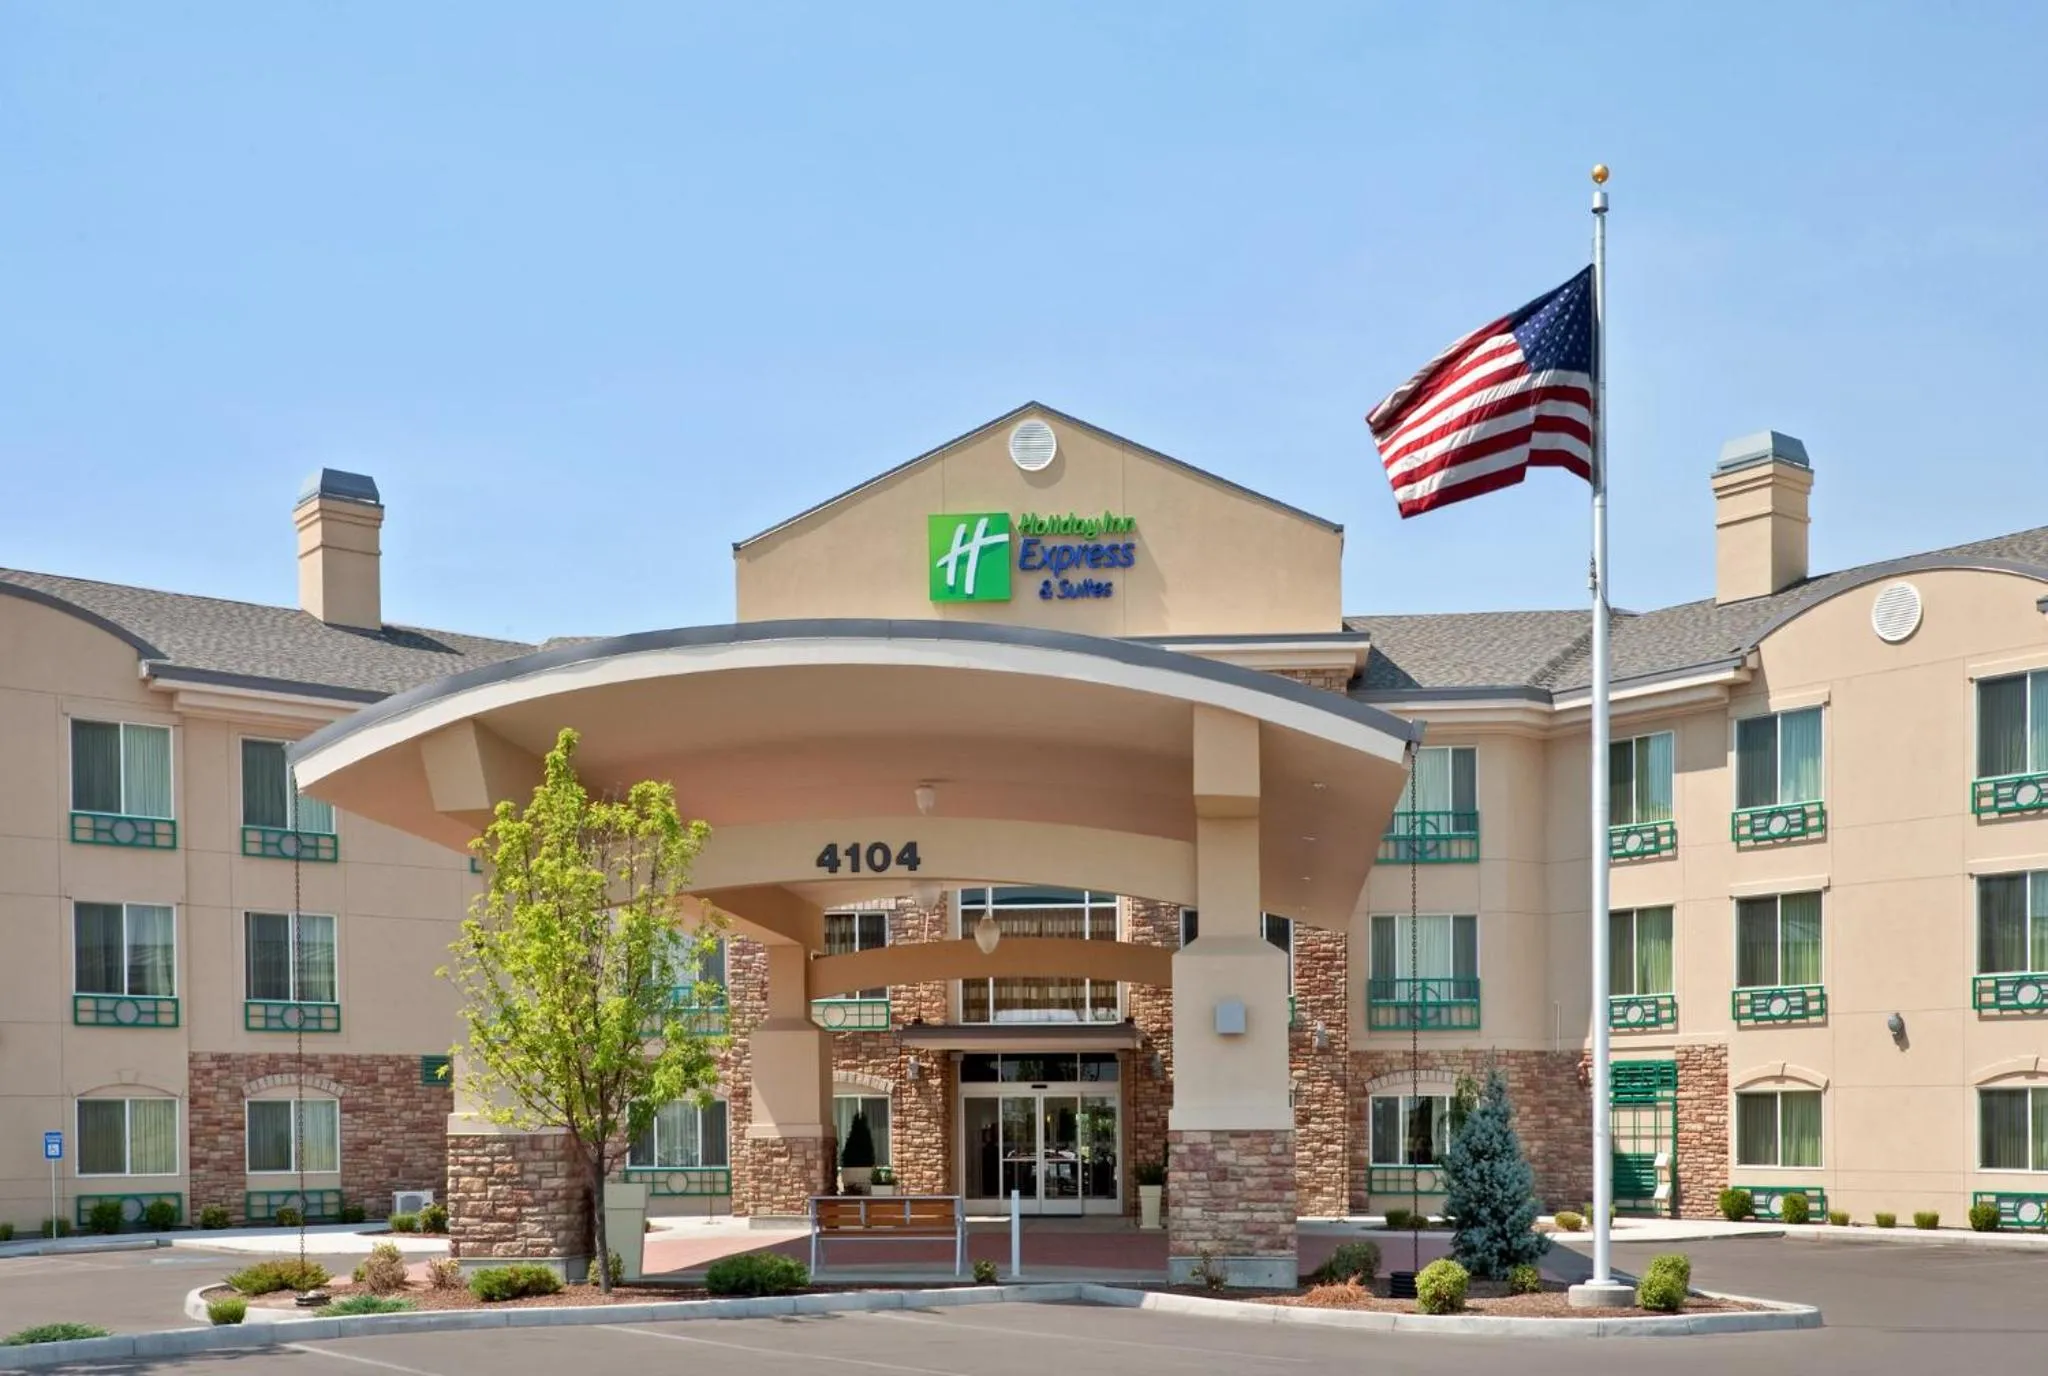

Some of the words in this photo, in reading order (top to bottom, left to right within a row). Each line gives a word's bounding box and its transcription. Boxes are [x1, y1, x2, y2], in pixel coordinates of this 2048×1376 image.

[1018, 512, 1099, 540] Holiday
[1103, 510, 1136, 533] Inn
[1018, 538, 1136, 577] Express
[1039, 579, 1053, 600] &
[1057, 578, 1114, 598] Suites
[816, 841, 921, 873] 4104
